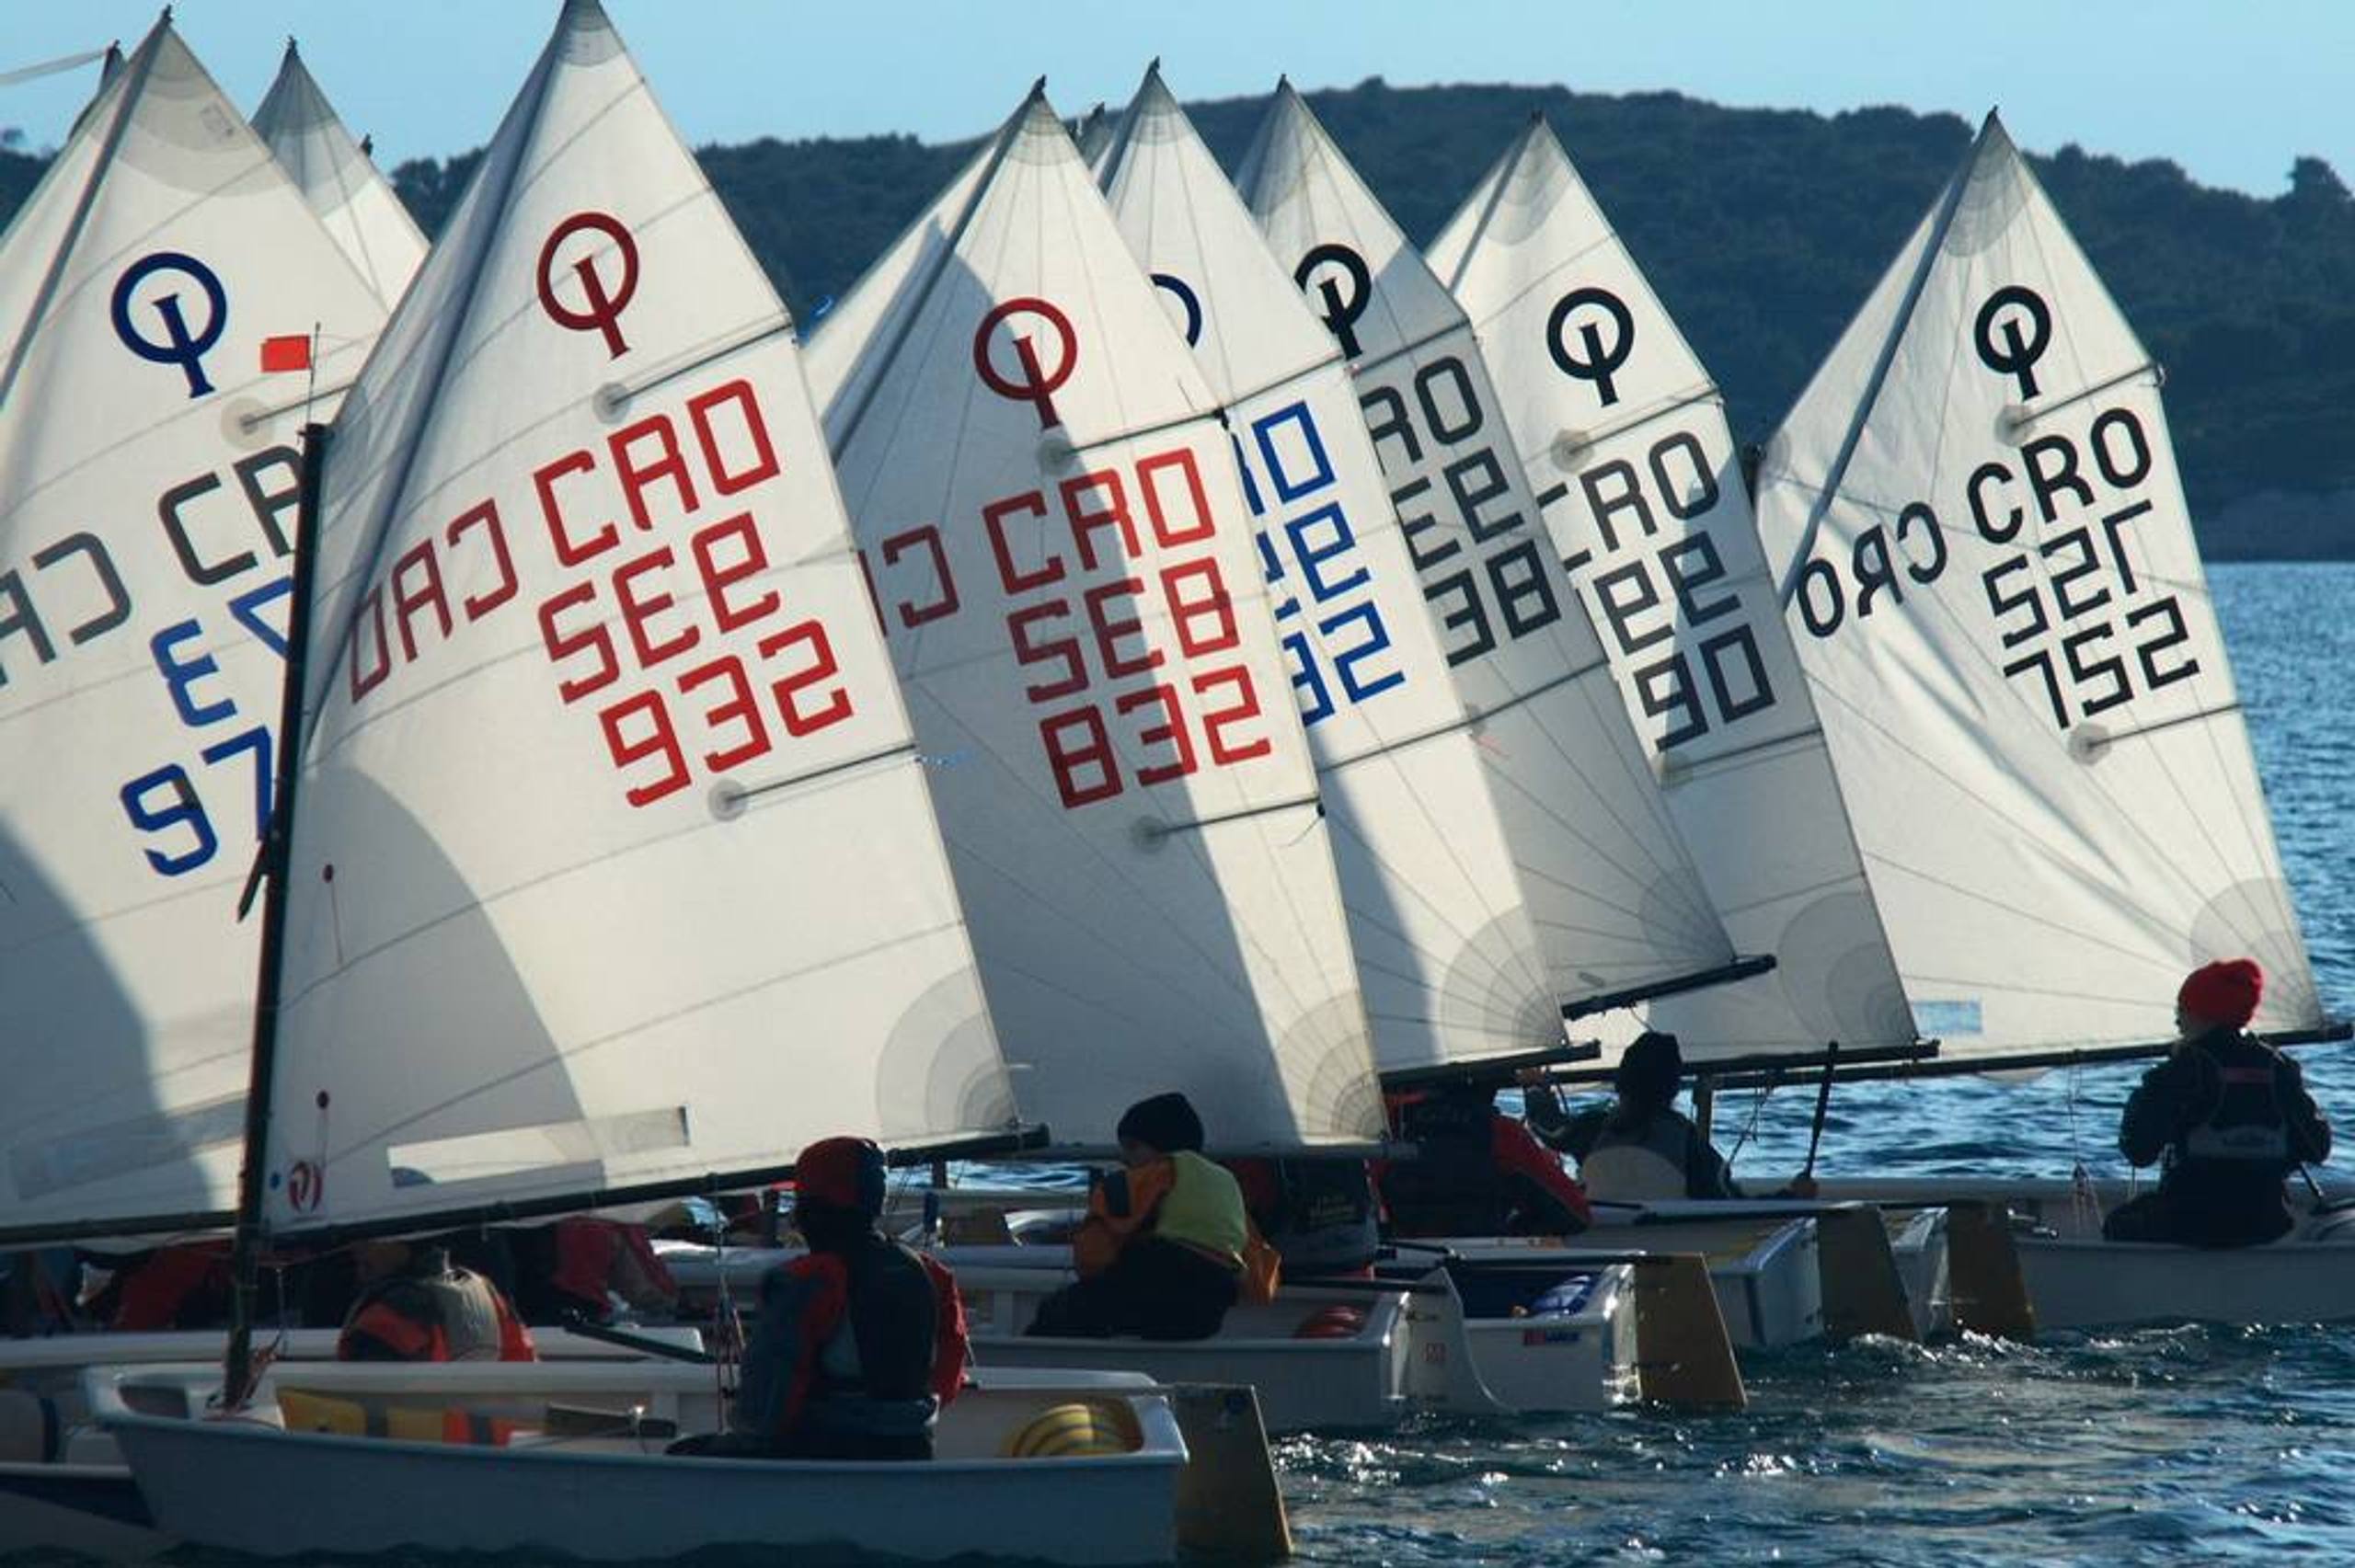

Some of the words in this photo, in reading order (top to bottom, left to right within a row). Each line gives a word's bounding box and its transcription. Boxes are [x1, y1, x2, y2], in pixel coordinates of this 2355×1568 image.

[533, 380, 781, 567] CRO
[1360, 356, 1483, 476] RO
[1967, 407, 2151, 544] CRO
[158, 445, 300, 586] CR
[982, 448, 1215, 594] CRO
[1424, 539, 1560, 668] 38
[2004, 597, 2200, 728] 752
[600, 619, 854, 807] 932
[1040, 664, 1271, 808] 832
[1634, 624, 1776, 752] 90
[120, 726, 274, 876] 97
